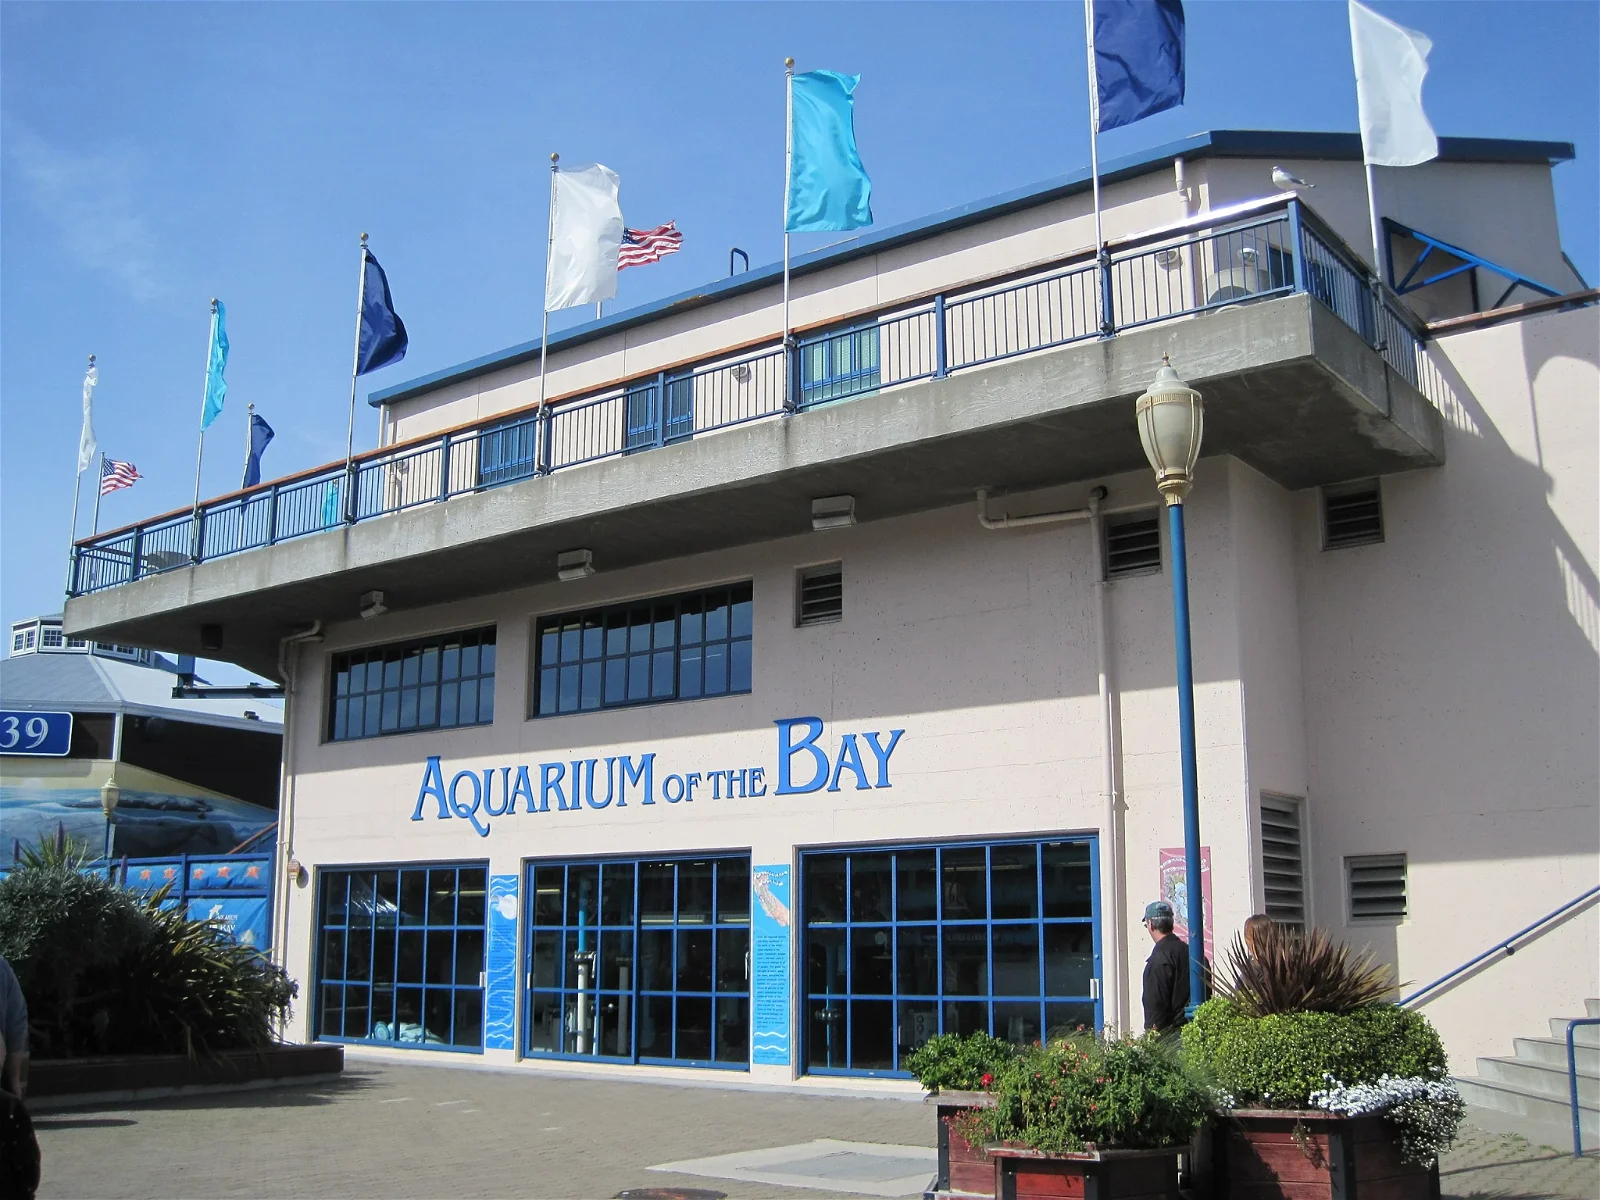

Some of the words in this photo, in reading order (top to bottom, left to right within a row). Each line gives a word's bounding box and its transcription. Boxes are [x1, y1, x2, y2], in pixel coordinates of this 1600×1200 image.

[0, 716, 49, 749] 39
[410, 753, 656, 837] AQUARIUM
[662, 772, 700, 803] OF
[706, 767, 768, 799] THE
[773, 716, 905, 796] BAY
